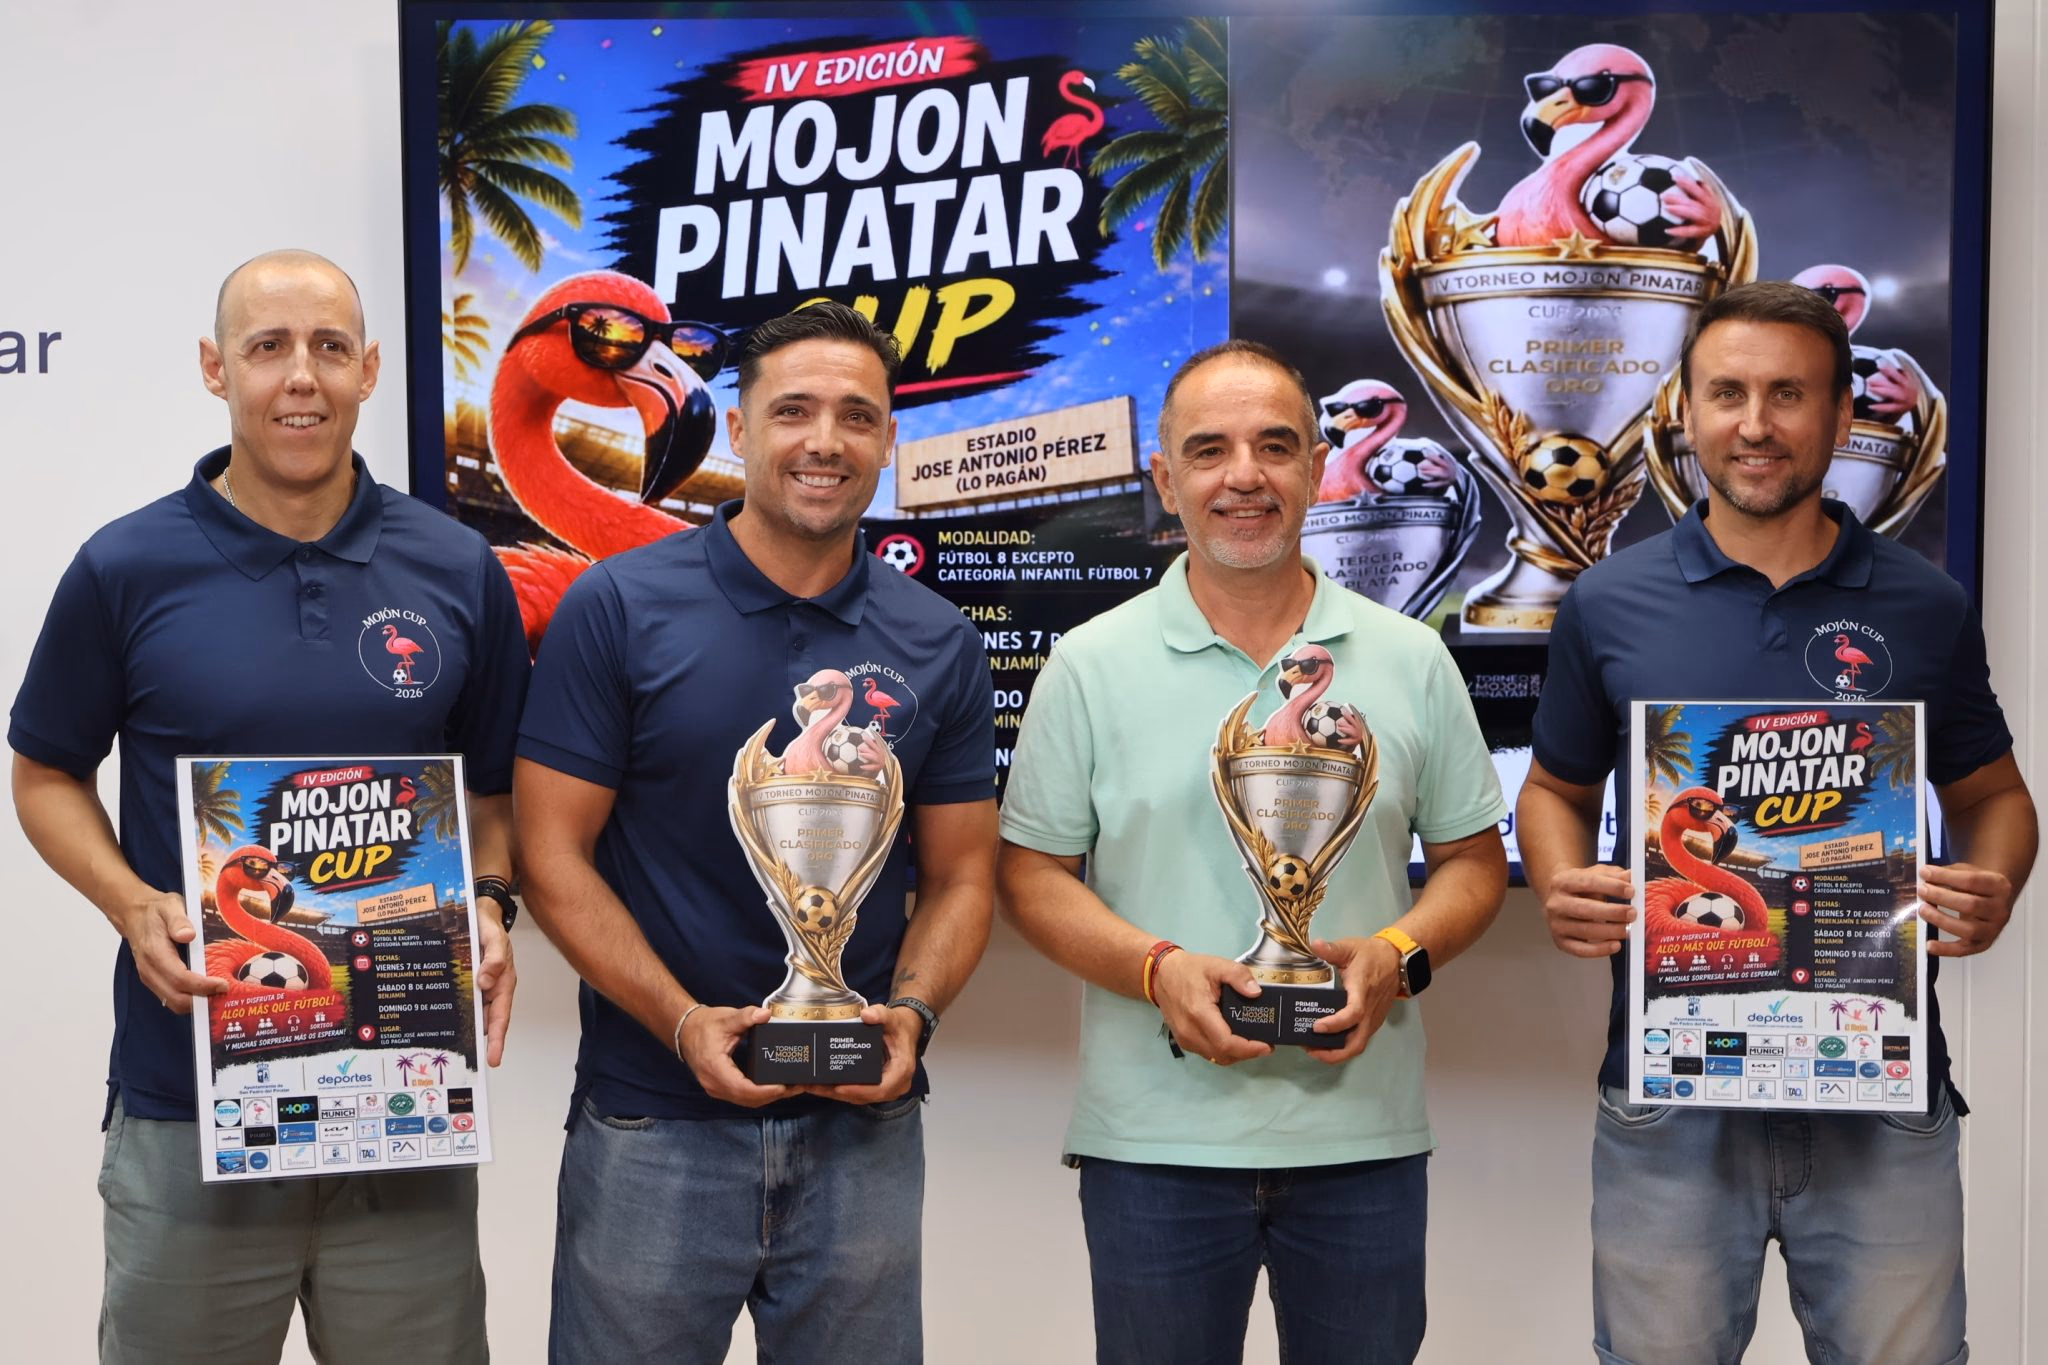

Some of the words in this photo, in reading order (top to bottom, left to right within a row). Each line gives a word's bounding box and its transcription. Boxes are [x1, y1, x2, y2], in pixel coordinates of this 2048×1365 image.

[764, 60, 807, 93] IV
[817, 42, 945, 88] EDICIÓN
[694, 76, 1029, 196] MOJON
[655, 168, 1083, 304] PINATAR
[1455, 272, 1535, 290] TORNEO
[1543, 271, 1621, 285] MOJON
[1526, 340, 1624, 355] PRIMER
[1489, 359, 1660, 375] CLASIFICADO
[967, 427, 1036, 452] ESTADIO
[911, 460, 953, 482] JOSE
[958, 448, 1039, 476] ANTONIO
[1043, 433, 1107, 460] PÉREZ
[956, 475, 981, 494] (LO
[985, 464, 1047, 490] PAGÁN)
[1345, 512, 1393, 523] MOJON
[938, 531, 1036, 545] MODALIDAD:
[938, 550, 993, 565] FÚTBOL
[997, 552, 1007, 565] 8
[1012, 551, 1075, 564] EXCEPTO
[1336, 552, 1404, 566] TERCER
[938, 566, 1016, 581] CATEGORÍA
[1021, 568, 1084, 581] INFANTIL
[1088, 565, 1141, 580] FÚTBOL
[1145, 568, 1153, 580] 7
[1325, 561, 1428, 579] LASIFICADO
[1344, 576, 1399, 590] PLATA
[362, 607, 400, 629] MOJÓN
[403, 610, 427, 626] CUP
[960, 606, 1012, 622] CHAS:
[1815, 619, 1859, 636] MOJÓN
[1861, 625, 1885, 642] CUP
[1029, 631, 1044, 650] 7
[844, 661, 881, 680] MOJÓN
[883, 667, 905, 684] CUP
[395, 688, 423, 698] 2026
[1755, 719, 1771, 730] IV
[1772, 713, 1818, 727] EDICIÓN
[1731, 724, 1847, 763] MOJON
[1244, 760, 1280, 768] TORNEO
[1284, 760, 1319, 769] MOJON
[303, 775, 318, 786] IV
[320, 769, 363, 783] EDICIÓN
[1717, 755, 1866, 798] PINATAR
[281, 779, 391, 820] MOJON
[765, 790, 802, 799] TORNEO
[805, 789, 842, 798] MOJON
[1274, 798, 1319, 809] PRIMER
[1754, 791, 1842, 828] CUP
[1256, 808, 1336, 820] CLASIFICADO
[270, 808, 412, 856] PINATAR
[797, 827, 844, 837] PRIMER
[779, 839, 861, 850] CLASIFICADO
[1821, 847, 1849, 857] ANTONIO
[1851, 843, 1874, 852] PÉREZ
[1824, 841, 1849, 850] ESTADIO
[310, 844, 392, 884] CUP
[1831, 854, 1852, 862] PAGÁN)
[362, 906, 376, 914] JOSE
[377, 901, 404, 911] ANTONIO
[405, 895, 426, 906] PÉREZ
[380, 894, 403, 903] ESTADIO
[388, 906, 408, 916] PAGÁN)
[1846, 909, 1851, 917] 7
[1814, 928, 1844, 937] SÁBADO
[1656, 944, 1680, 954] ALGO
[1682, 940, 1703, 951] MÁS
[1706, 941, 1726, 950] QUE
[1728, 937, 1770, 949] FÚTBOL!
[1665, 975, 1690, 983] MUCHAS
[1691, 973, 1725, 981] SORPRESAS
[1726, 971, 1739, 979] MÁS
[1751, 969, 1780, 978] ESPERAN!
[377, 983, 406, 992] SÁBADO
[408, 983, 413, 991] 8
[221, 1008, 246, 1020] ALGO
[248, 1003, 269, 1016] MÁS
[271, 1002, 291, 1013] QUE
[294, 995, 336, 1010] FÚTBOL!
[379, 1004, 413, 1013] DOMINGO
[1295, 1006, 1335, 1014] CLASIFICADO
[1747, 1013, 1803, 1024] deportes
[224, 1032, 246, 1040] FAMILIA
[231, 1041, 257, 1050] MUCHAS
[258, 1036, 292, 1046] SORPRESAS
[317, 1029, 347, 1038] ESPERAN!
[1750, 1047, 1784, 1055] MUNICH
[317, 1073, 372, 1086] deportes
[321, 1109, 355, 1118] MUNICH
